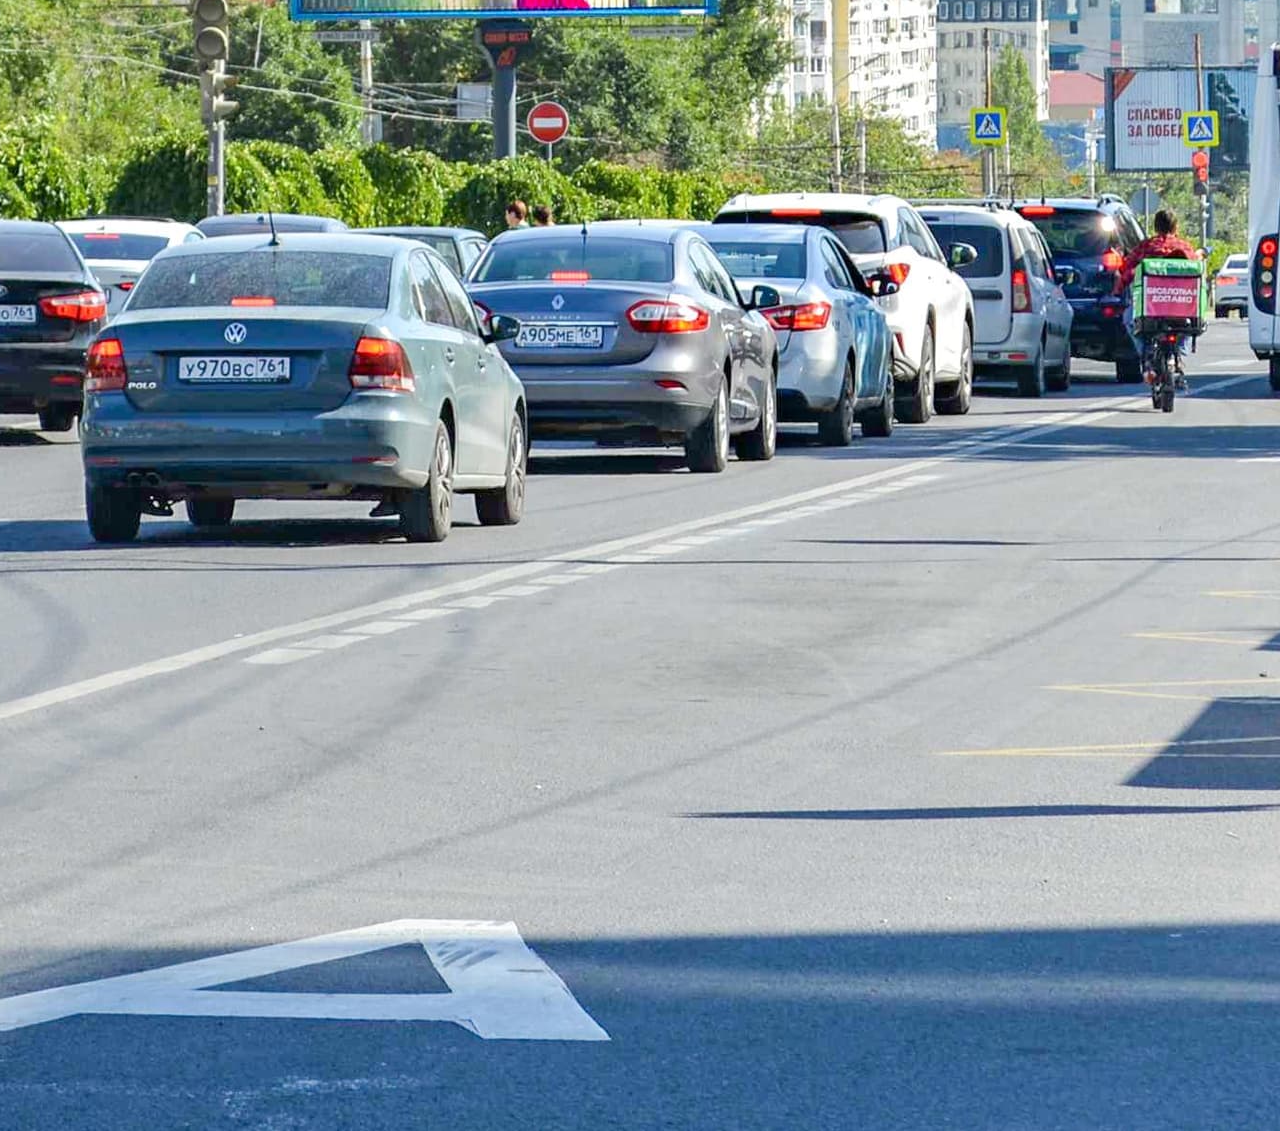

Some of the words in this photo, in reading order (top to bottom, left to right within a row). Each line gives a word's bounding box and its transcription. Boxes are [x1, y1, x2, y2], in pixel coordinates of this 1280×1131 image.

[1127, 108, 1182, 121] СПАСИБО
[1127, 124, 1143, 137] ЗА
[1147, 124, 1184, 138] ПОБЕД
[11, 306, 34, 317] 761
[520, 327, 575, 342] А905МЕ
[578, 326, 599, 339] 161
[185, 359, 255, 377] У970ВС
[257, 358, 286, 373] 761
[128, 381, 157, 390] POLO
